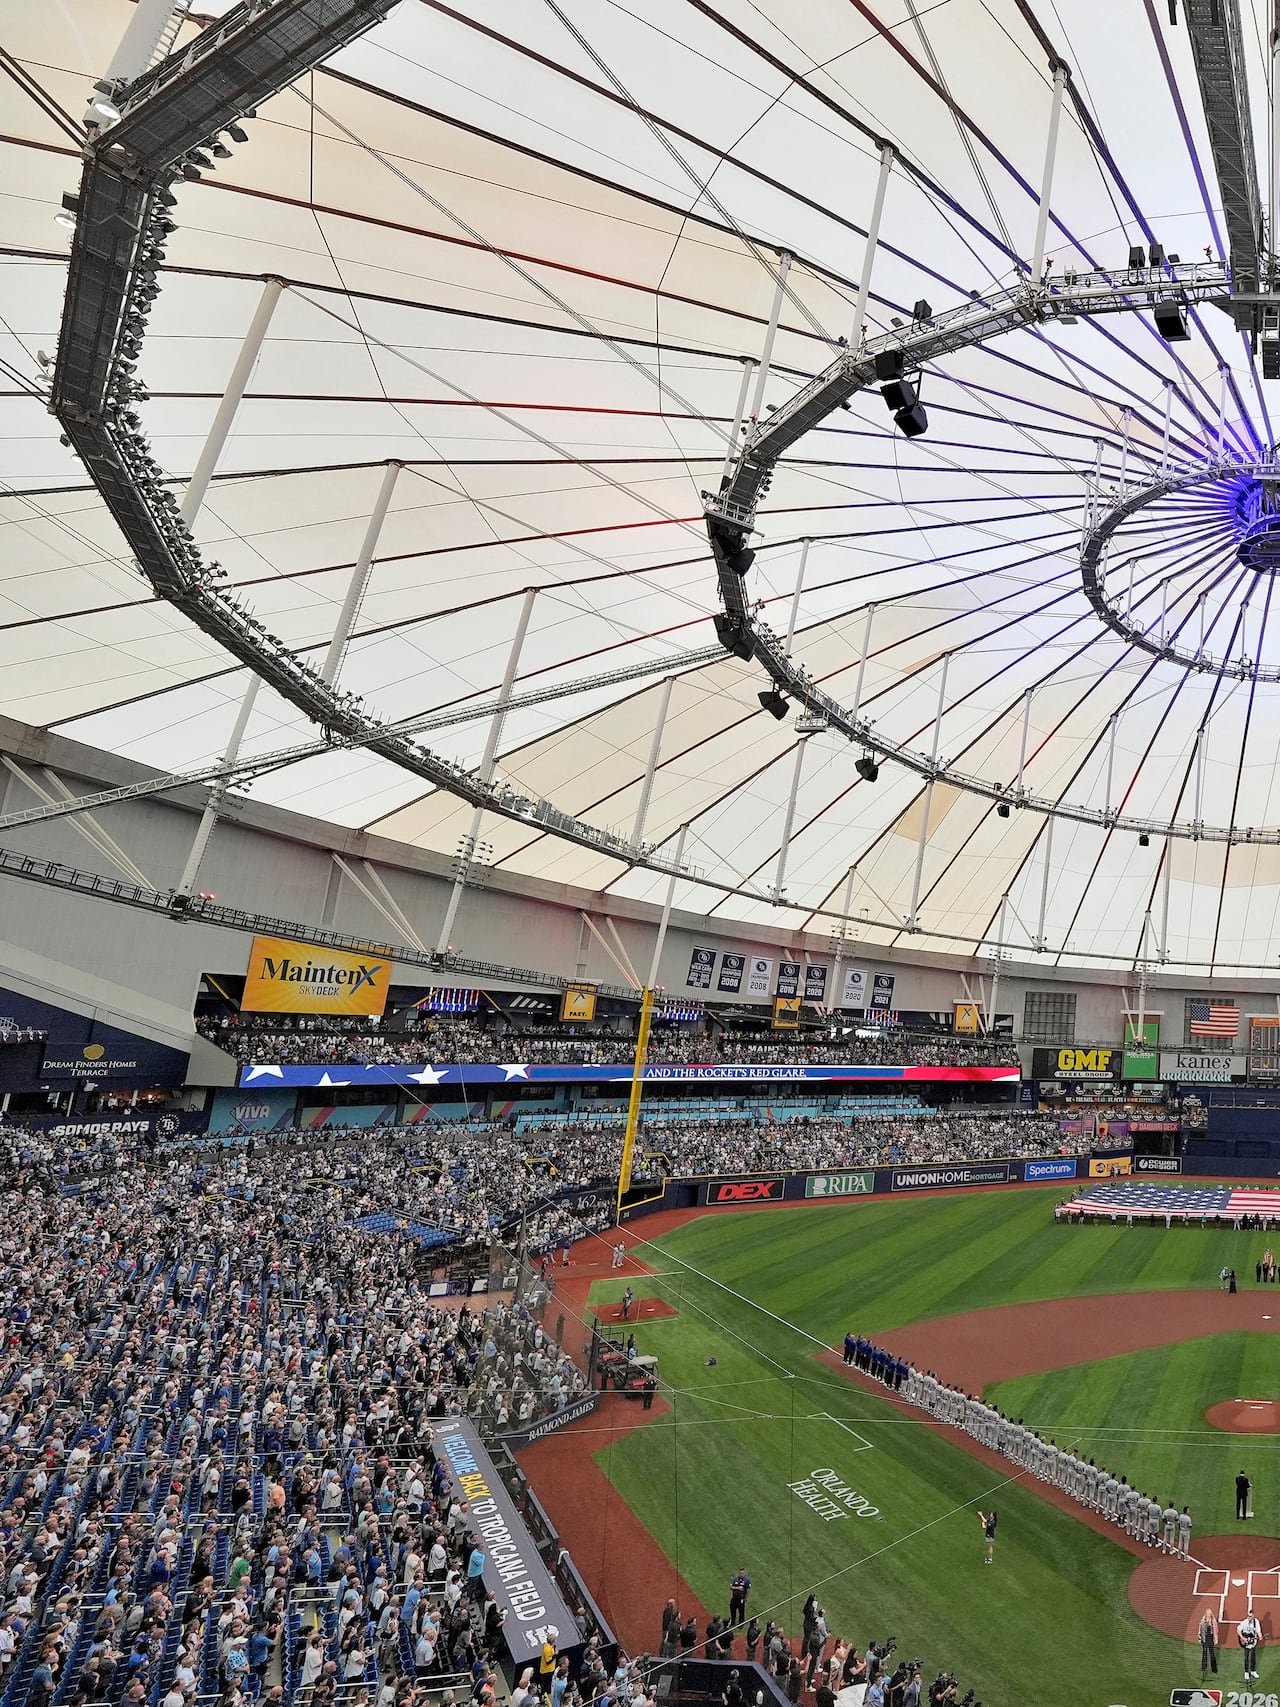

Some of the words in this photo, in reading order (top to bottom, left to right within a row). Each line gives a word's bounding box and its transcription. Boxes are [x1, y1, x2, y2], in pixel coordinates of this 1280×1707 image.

[260, 957, 382, 995] MaintenX
[43, 1060, 74, 1069] DREAM
[75, 1060, 108, 1069] FINDERS
[108, 1060, 137, 1068] HOMES
[1058, 1049, 1112, 1071] GMF
[1176, 1054, 1231, 1069] kanes
[70, 1068, 108, 1077] TERRACE
[646, 1068, 670, 1078] AND
[673, 1068, 695, 1078] THE
[697, 1068, 747, 1078] ROCKET'S
[750, 1068, 770, 1078] RED
[55, 1122, 111, 1137] SOMOS
[112, 1121, 149, 1133] RAYS
[1029, 1164, 1068, 1177] Spectrum
[717, 1182, 775, 1201] DEX
[827, 1175, 868, 1194] RIPA
[528, 1413, 570, 1441] RAYMOND
[569, 1400, 595, 1423] JAMES
[442, 1433, 480, 1476] WELCOME
[458, 1473, 491, 1501] BACK
[810, 1468, 880, 1517] ORLANDO
[470, 1498, 498, 1516] TO
[786, 1478, 847, 1521] HEALTH
[477, 1513, 528, 1583] TROPICANA
[505, 1579, 546, 1622] FIELD
[1226, 1691, 1279, 1707] 2026
